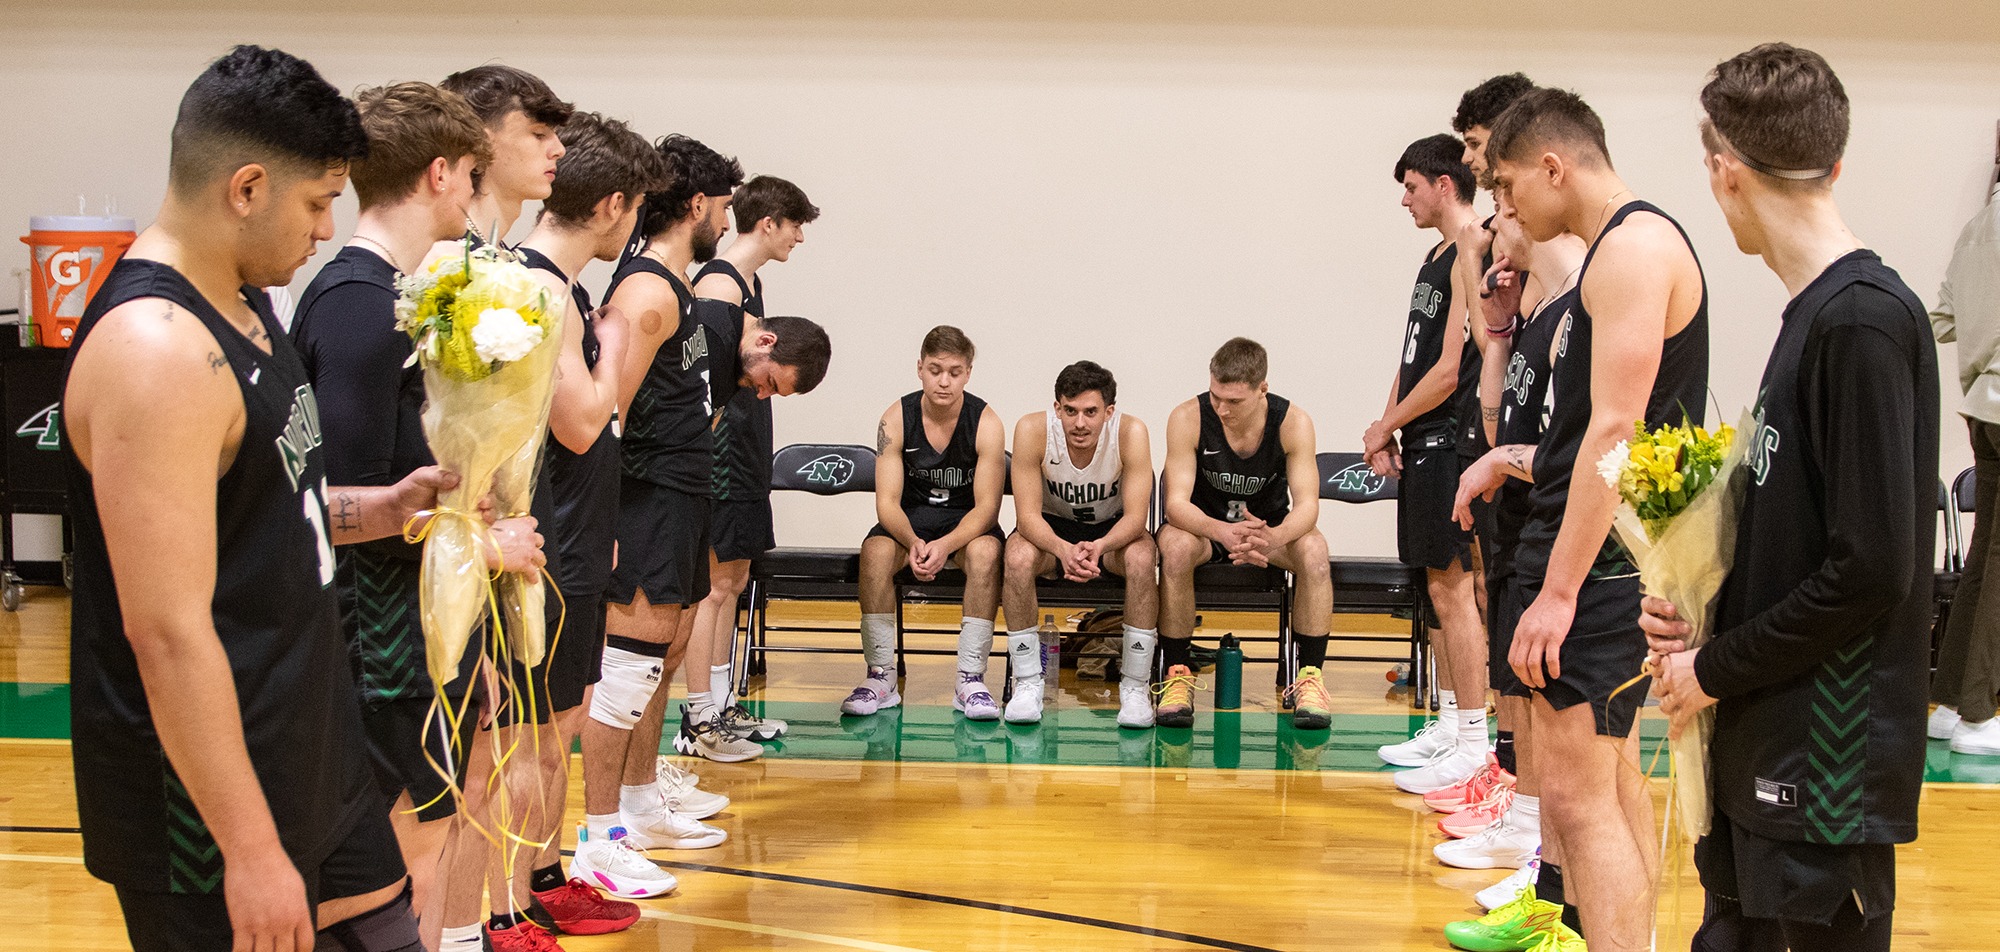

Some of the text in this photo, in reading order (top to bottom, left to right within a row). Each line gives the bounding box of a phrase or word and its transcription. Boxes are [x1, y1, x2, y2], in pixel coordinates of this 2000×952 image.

[51, 251, 81, 286] G
[808, 462, 838, 483] N
[1339, 470, 1369, 491] N
[1047, 479, 1119, 504] NICHOLS
[1226, 500, 1248, 521] 8
[1782, 790, 1790, 801] L
